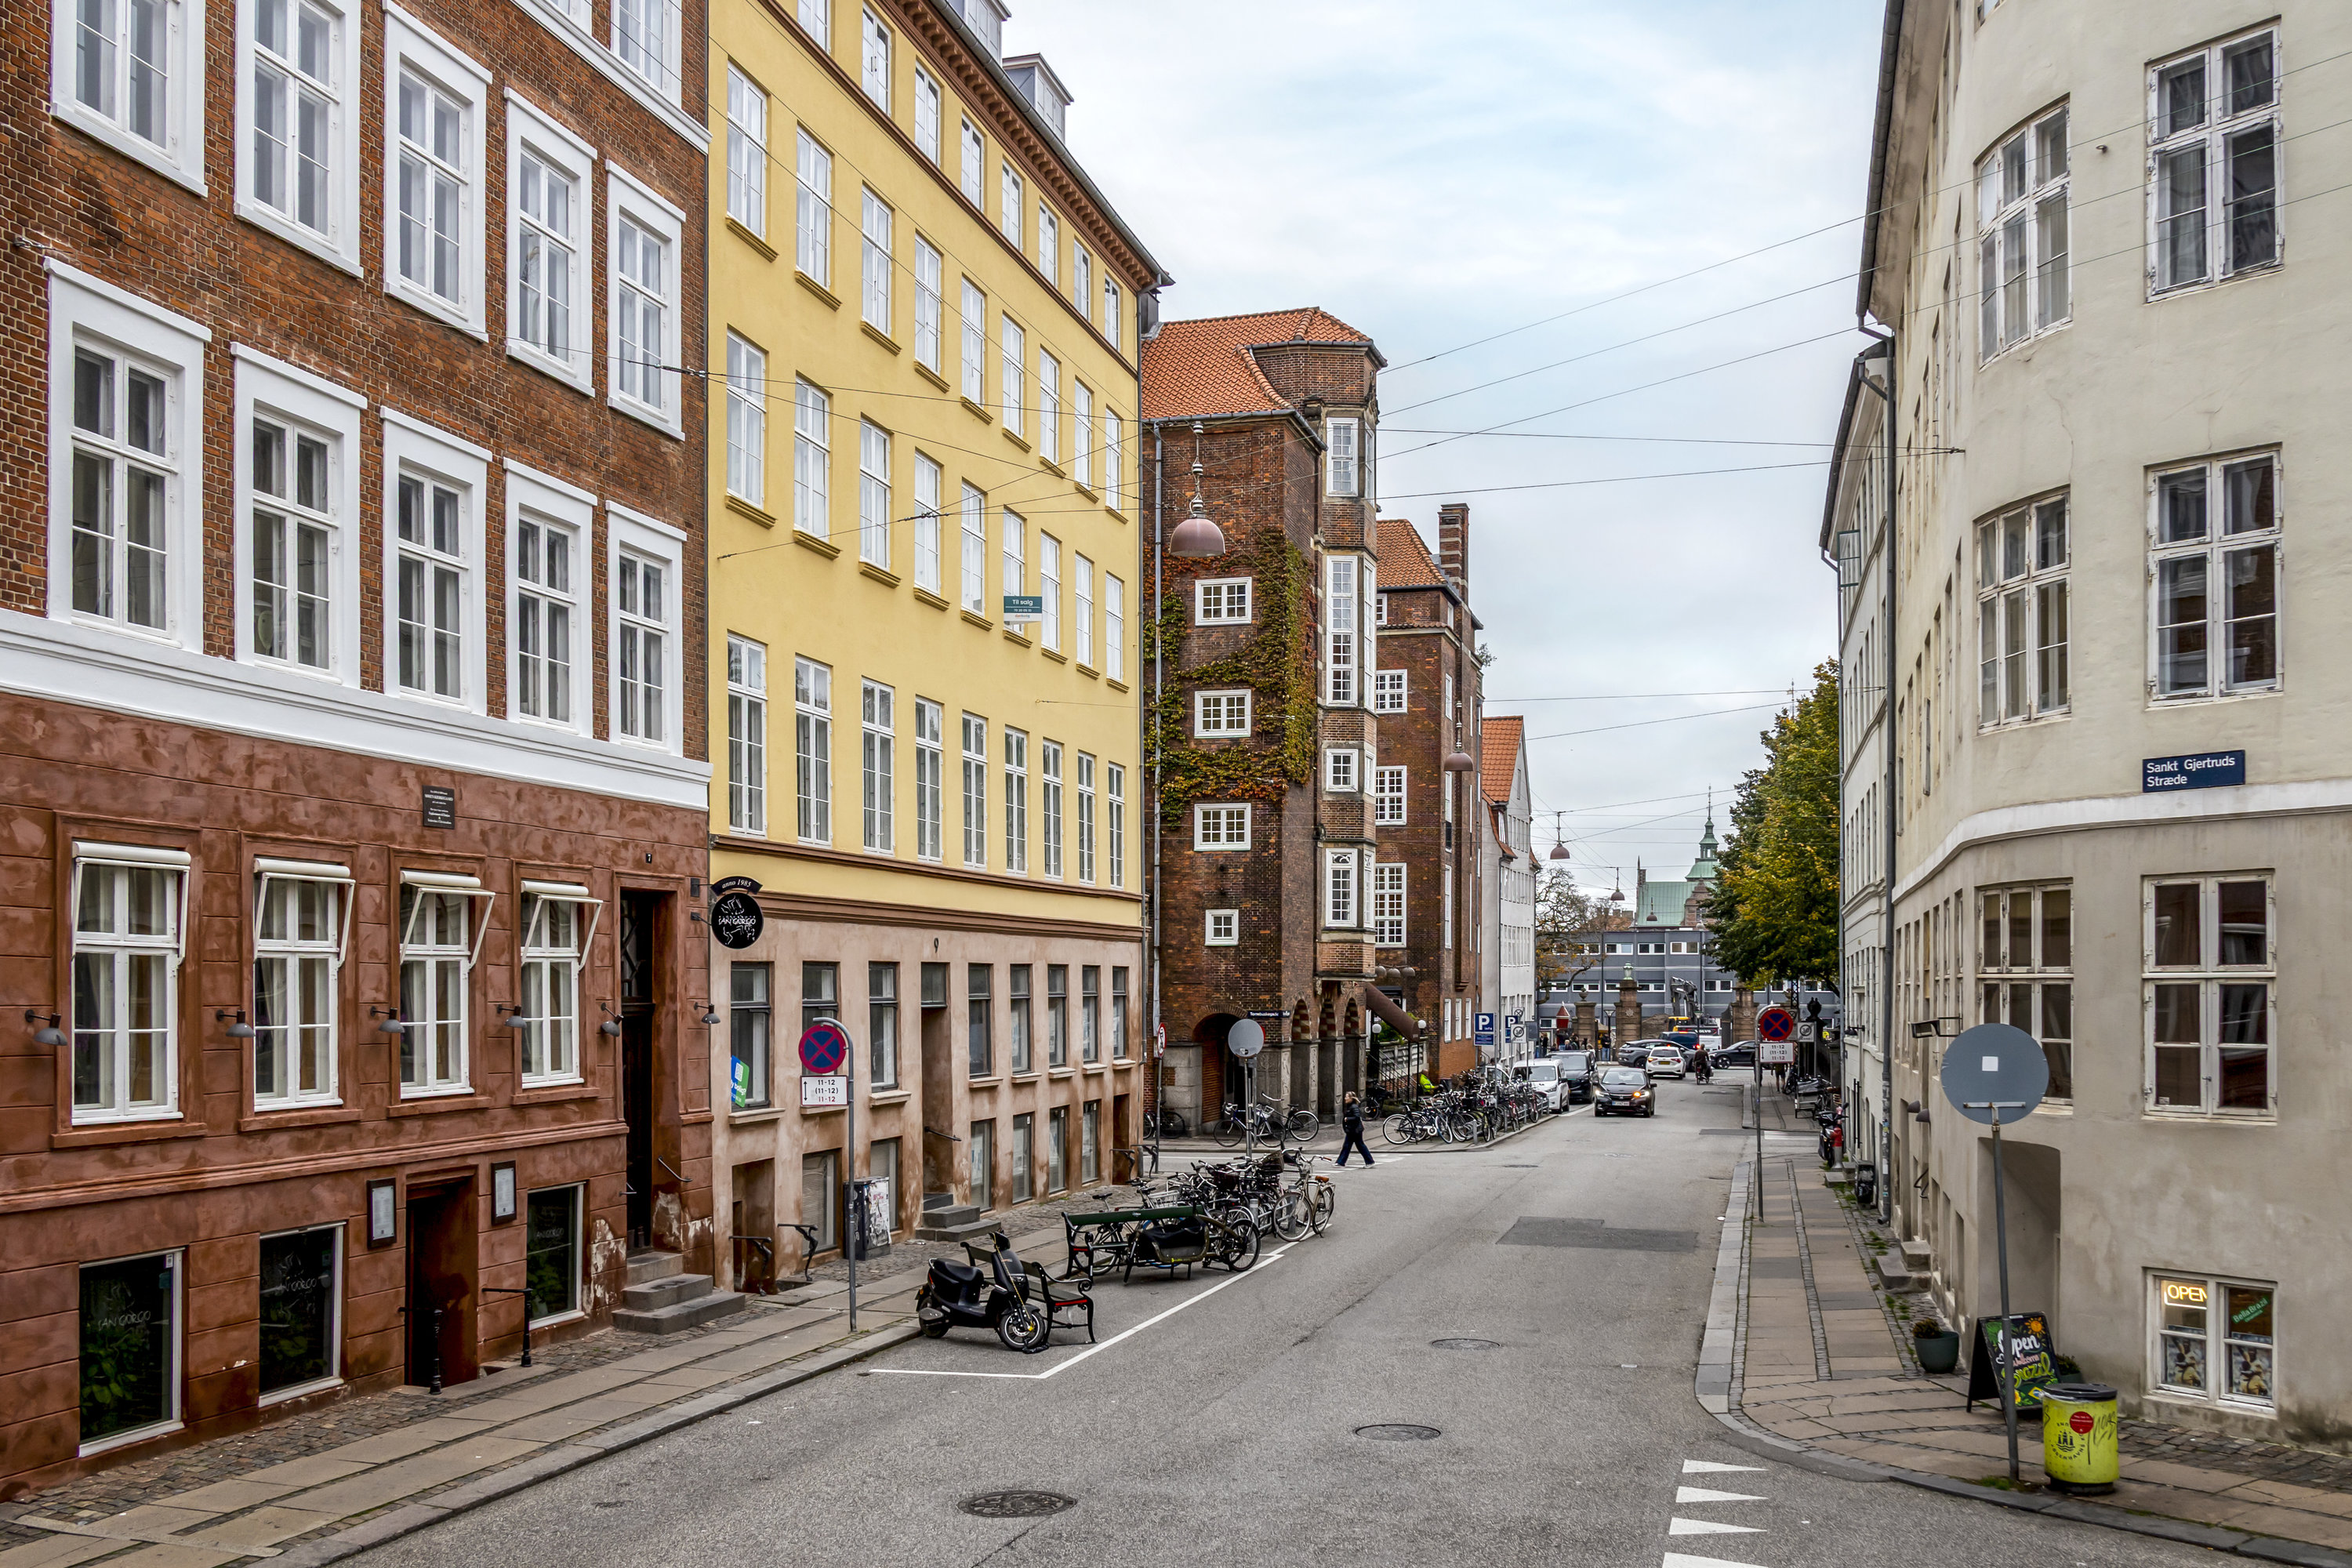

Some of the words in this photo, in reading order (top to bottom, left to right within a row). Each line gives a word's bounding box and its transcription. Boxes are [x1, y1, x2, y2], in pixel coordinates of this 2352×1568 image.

[2147, 760, 2178, 773] Sankt
[2183, 756, 2235, 771] Gjertruds
[2147, 775, 2187, 787] Stræde
[934, 938, 938, 953] 9
[1479, 1014, 1490, 1030] P
[1508, 1017, 1515, 1027] P
[2167, 1284, 2208, 1302] OPEN
